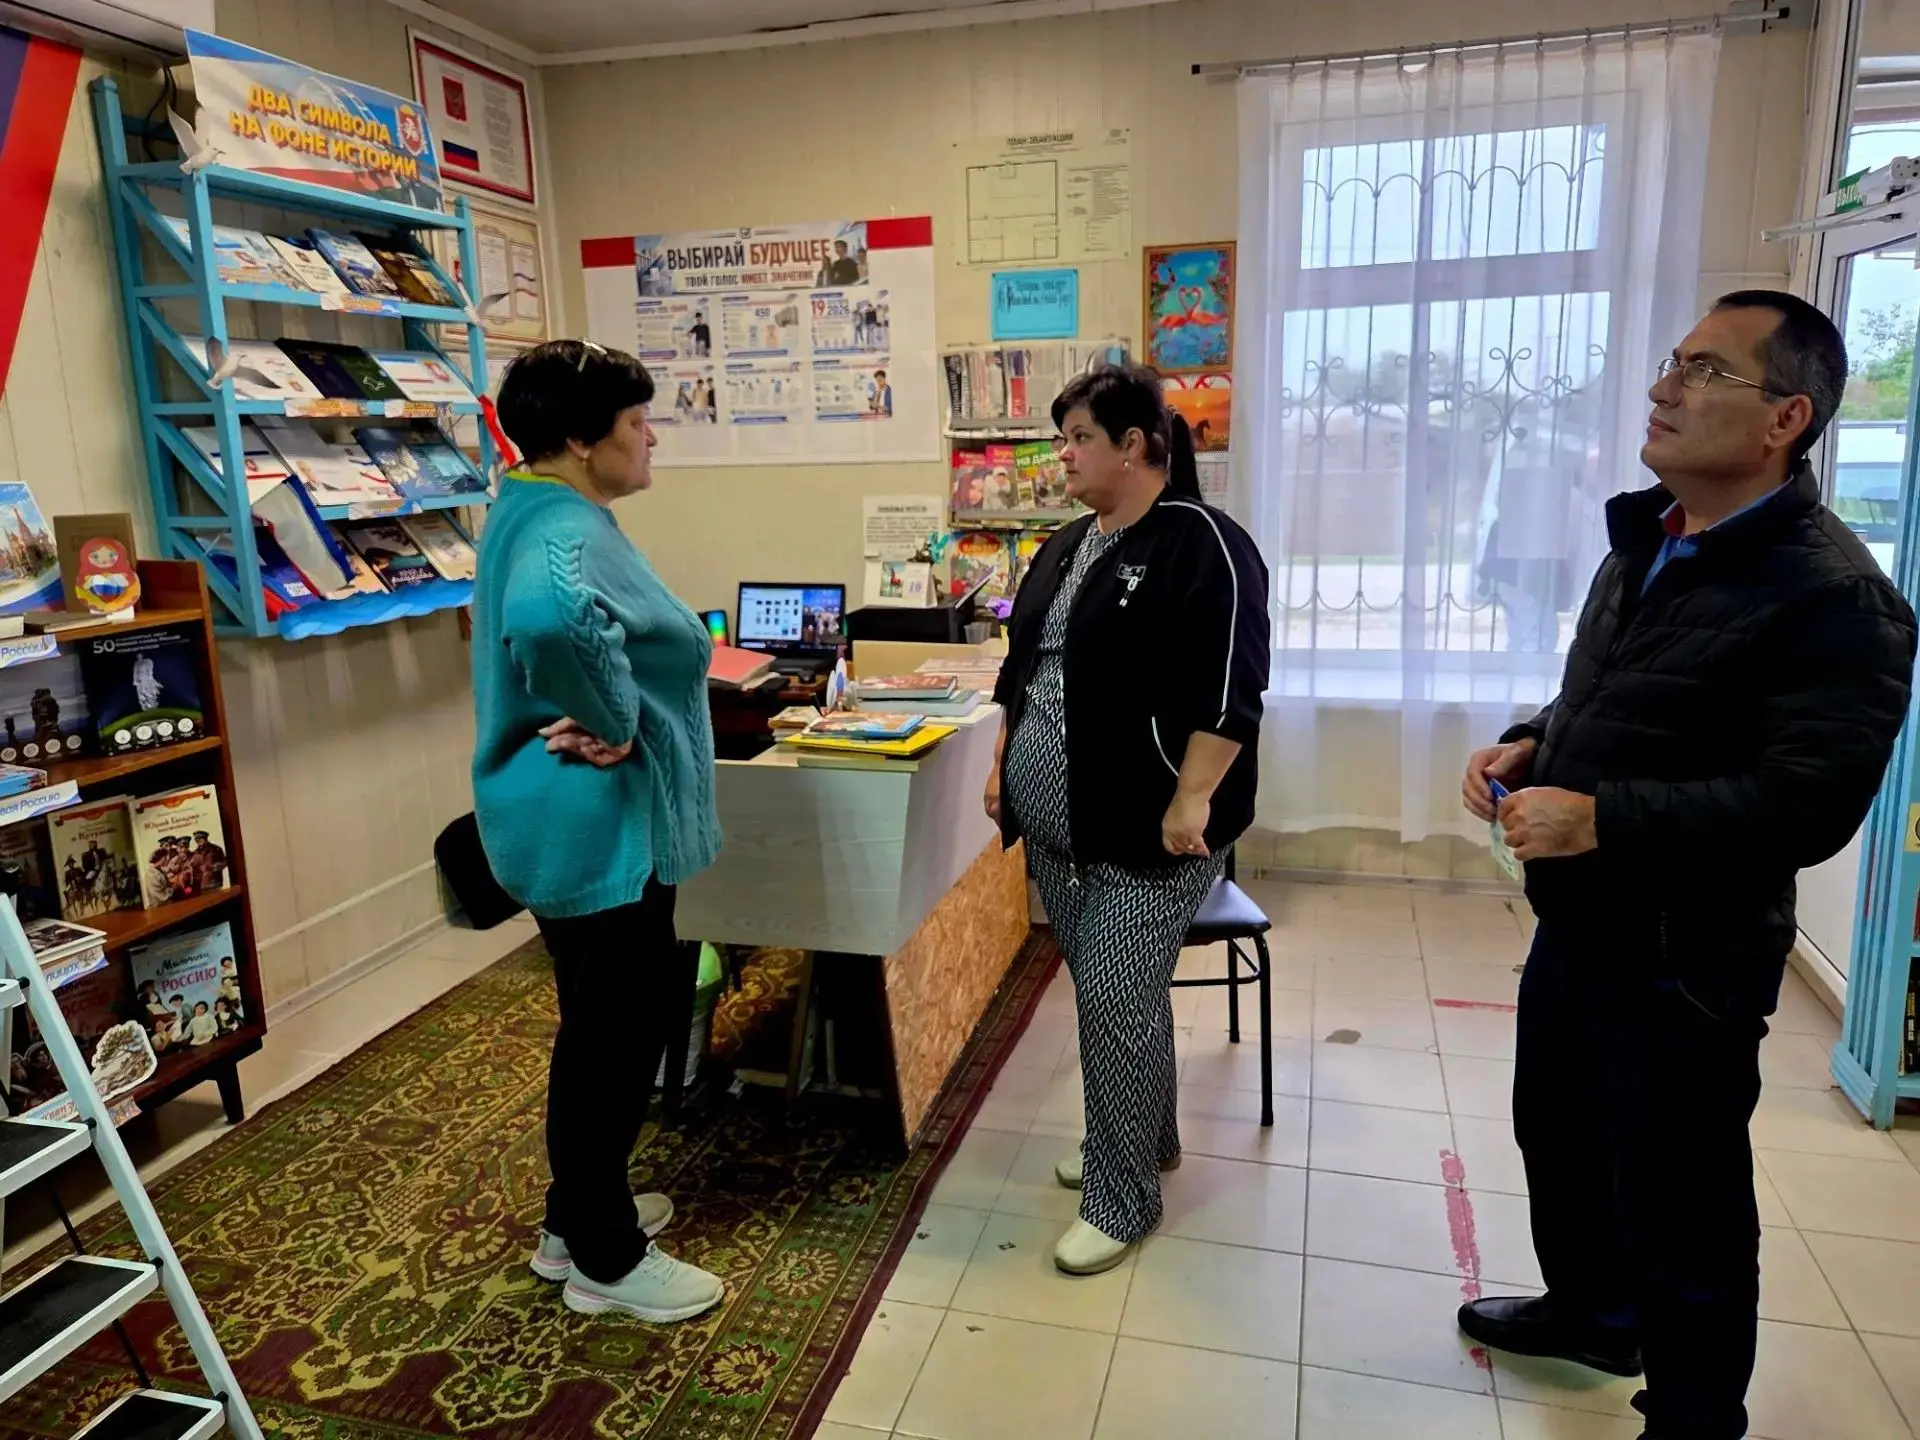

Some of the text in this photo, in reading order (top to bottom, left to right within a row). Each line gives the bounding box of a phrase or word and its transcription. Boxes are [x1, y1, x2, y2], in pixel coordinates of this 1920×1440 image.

[247, 83, 393, 146] ДВА СИМВОЛА
[229, 111, 419, 181] НА ФОНЕ ИСТОРИИ
[667, 238, 831, 271] ВЫБИРАЙ БУДУЩЕЕ
[685, 270, 815, 287] ТВОЙ ГОЛОС ИМЕЕТ ЗНАЧЕНИЕ
[811, 300, 825, 316] 19
[92, 639, 115, 654] 50
[20, 791, 61, 812] Россию
[160, 966, 218, 993] РОССИЮ
